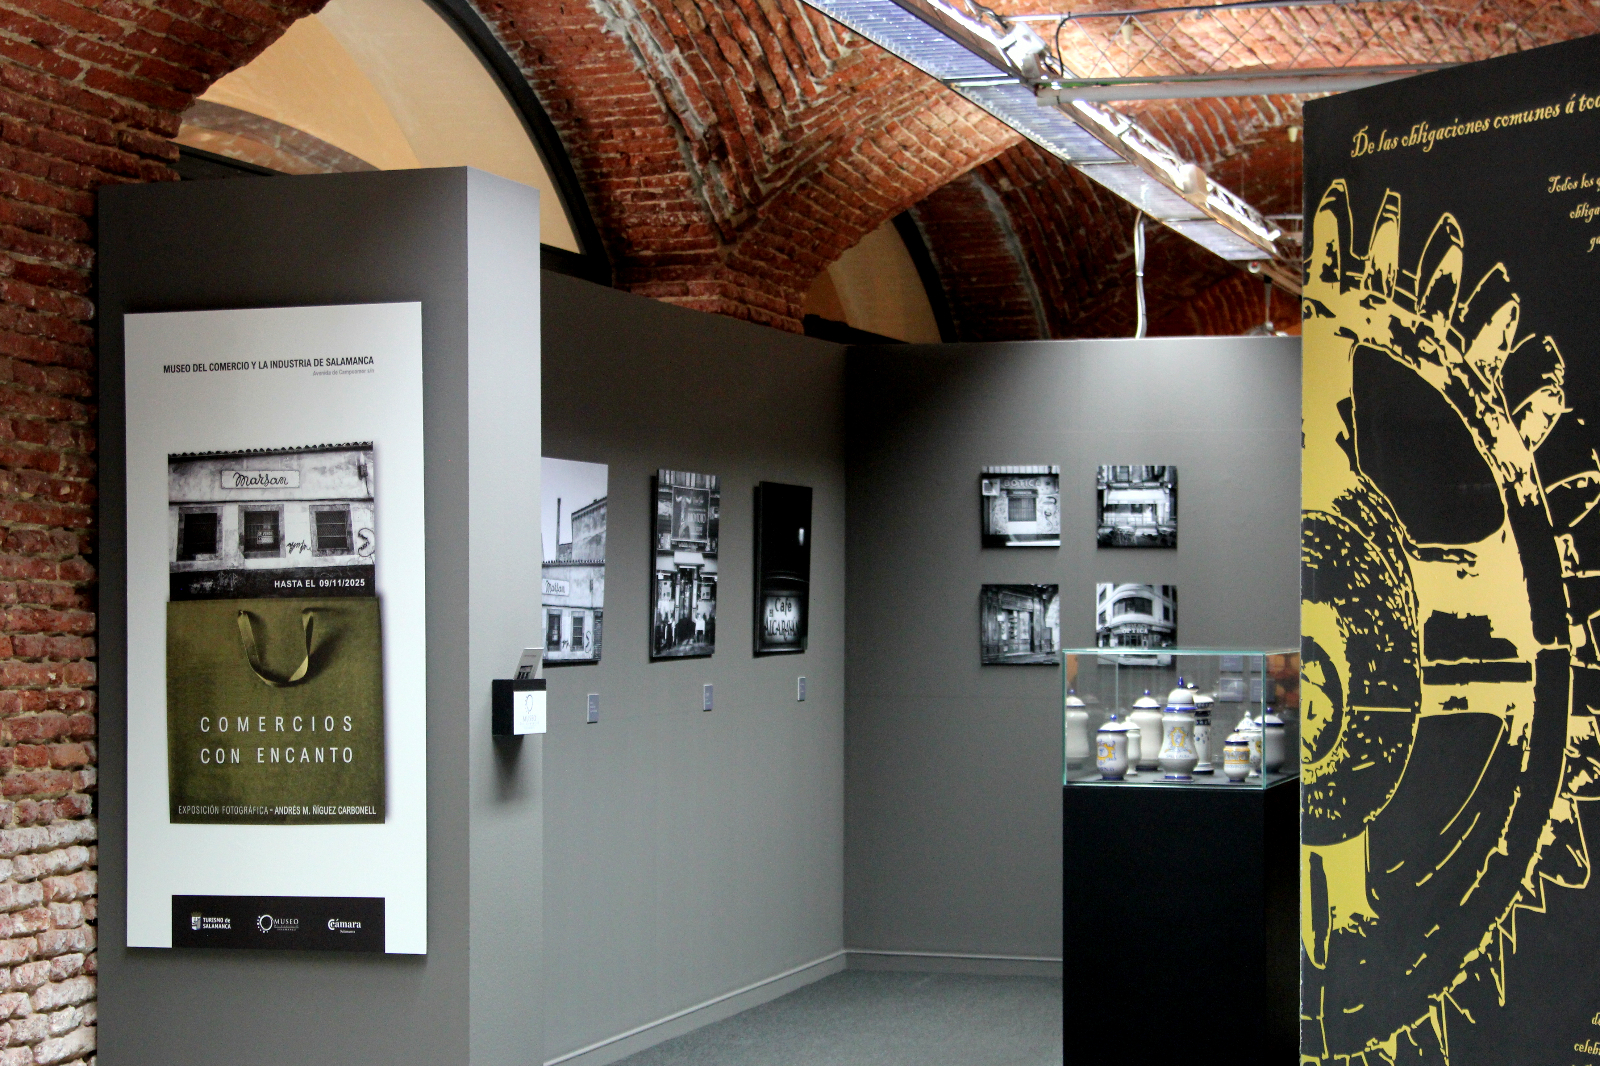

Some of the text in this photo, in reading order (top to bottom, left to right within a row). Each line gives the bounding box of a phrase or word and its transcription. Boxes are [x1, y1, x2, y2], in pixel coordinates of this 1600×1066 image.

[1350, 125, 1374, 157] De
[1377, 129, 1398, 152] las
[1401, 117, 1490, 152] obligaciones
[1494, 103, 1560, 128] comunes
[1548, 175, 1578, 193] Todos
[1580, 173, 1594, 188] los
[163, 356, 374, 374] MUSEO DEL COMERCIO Y LA INDUSTRIA DE SALAMANCA
[274, 578, 366, 588] HASTA EL 09/11/2025
[200, 715, 352, 733] COMERCIOS
[200, 747, 353, 764] CON ENCANTO
[178, 804, 219, 815] EXPOSICIÓN
[221, 804, 269, 815] FOTOGRÁFICA
[274, 804, 301, 815] ANDRÉS
[302, 805, 311, 815] M.
[337, 805, 377, 815] CARBONELL
[327, 918, 362, 931] Cámara
